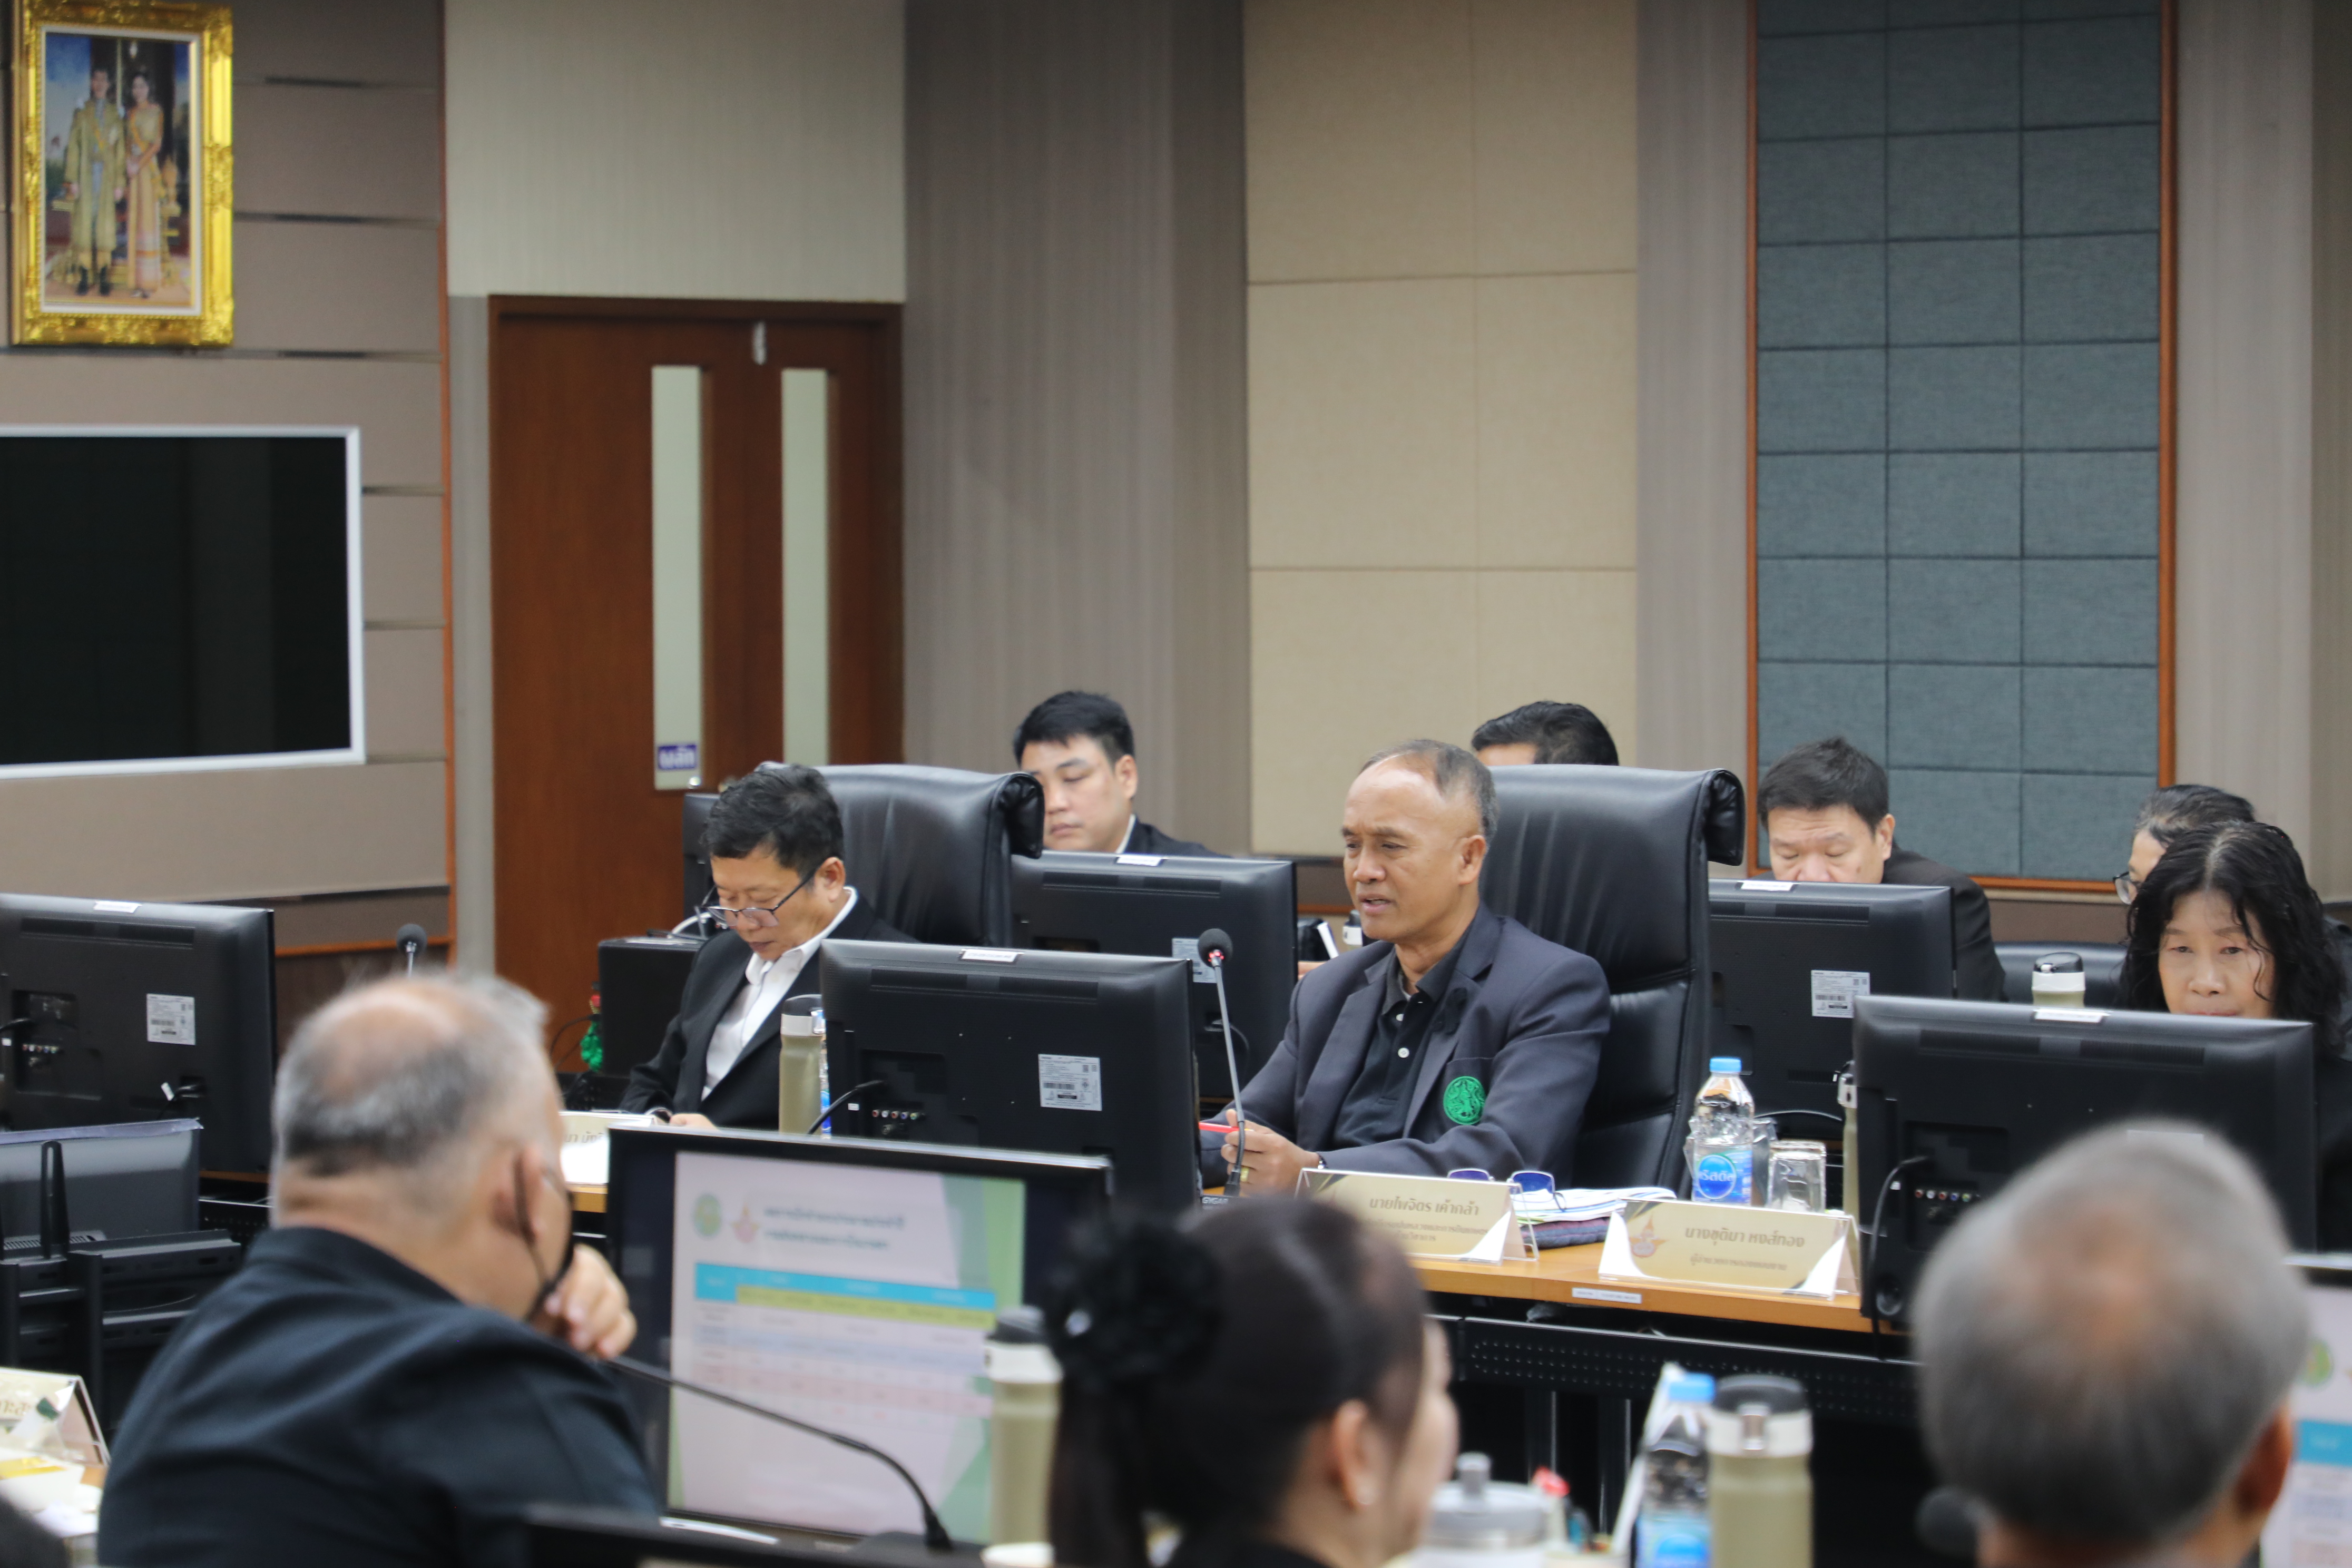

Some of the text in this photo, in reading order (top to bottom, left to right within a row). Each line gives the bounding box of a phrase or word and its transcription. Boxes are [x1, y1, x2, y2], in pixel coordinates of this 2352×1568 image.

[1369, 1196, 1479, 1216] นายไพจิตร เค้ากล้า
[1685, 1227, 1805, 1248] นางชุติมา หงส์ทอง
